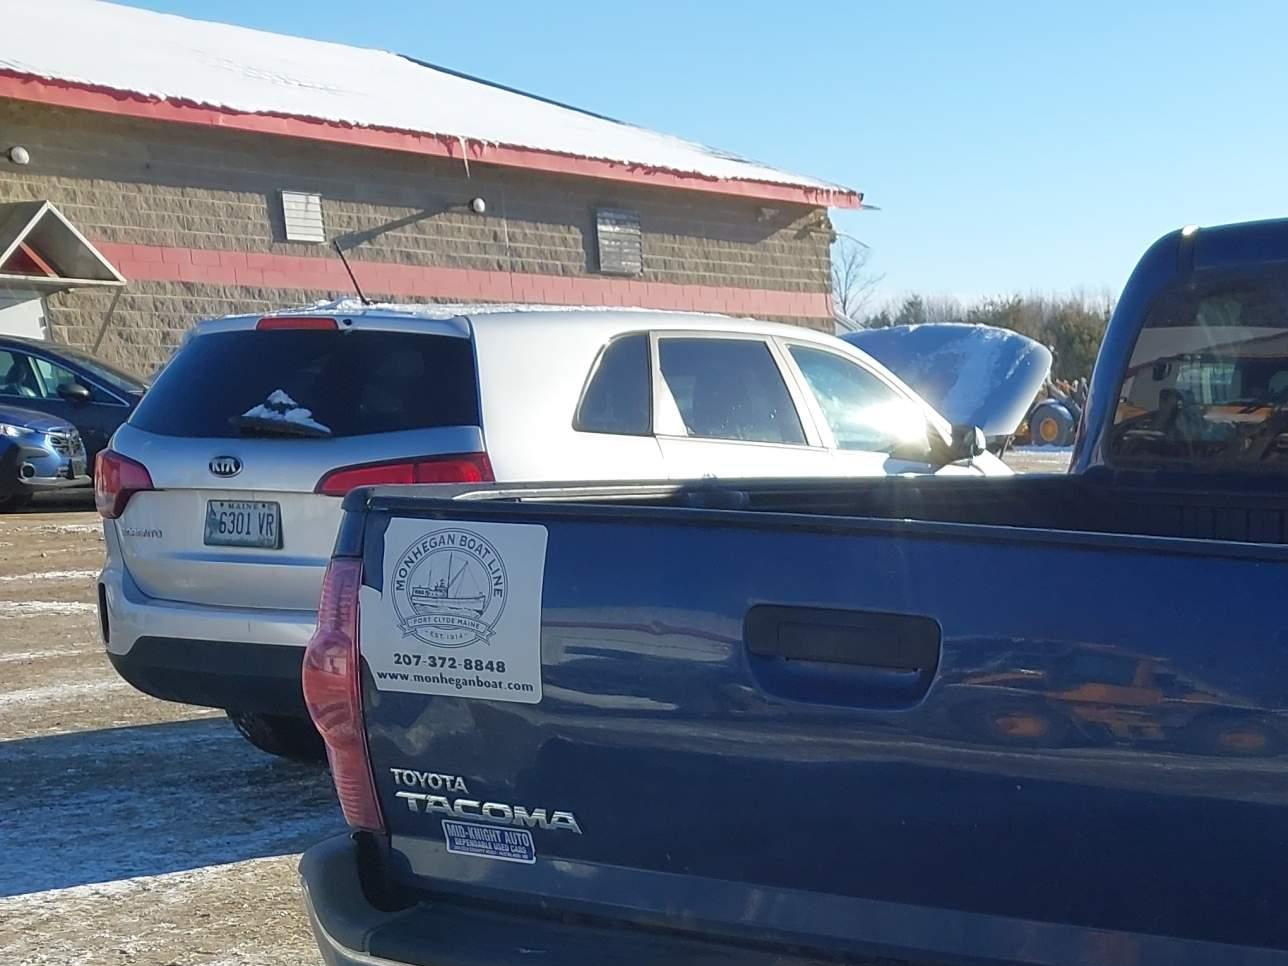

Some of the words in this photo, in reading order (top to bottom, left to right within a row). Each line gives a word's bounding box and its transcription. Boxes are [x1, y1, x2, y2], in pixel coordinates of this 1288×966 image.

[211, 459, 237, 474] KIA
[219, 511, 251, 536] 6301
[258, 511, 274, 537] VR
[396, 534, 456, 591] MONHEGAN
[459, 535, 491, 559] BOAT
[487, 559, 503, 598] LINE
[413, 616, 431, 625] PORT
[433, 616, 455, 624] CLYDE
[457, 618, 480, 629] MAINE
[393, 653, 506, 673] 207-372-8848
[377, 670, 534, 692] www.monheganboat.com
[389, 767, 469, 794] TOYOTA
[395, 791, 583, 835] TACOMA
[505, 831, 530, 847] AUTO
